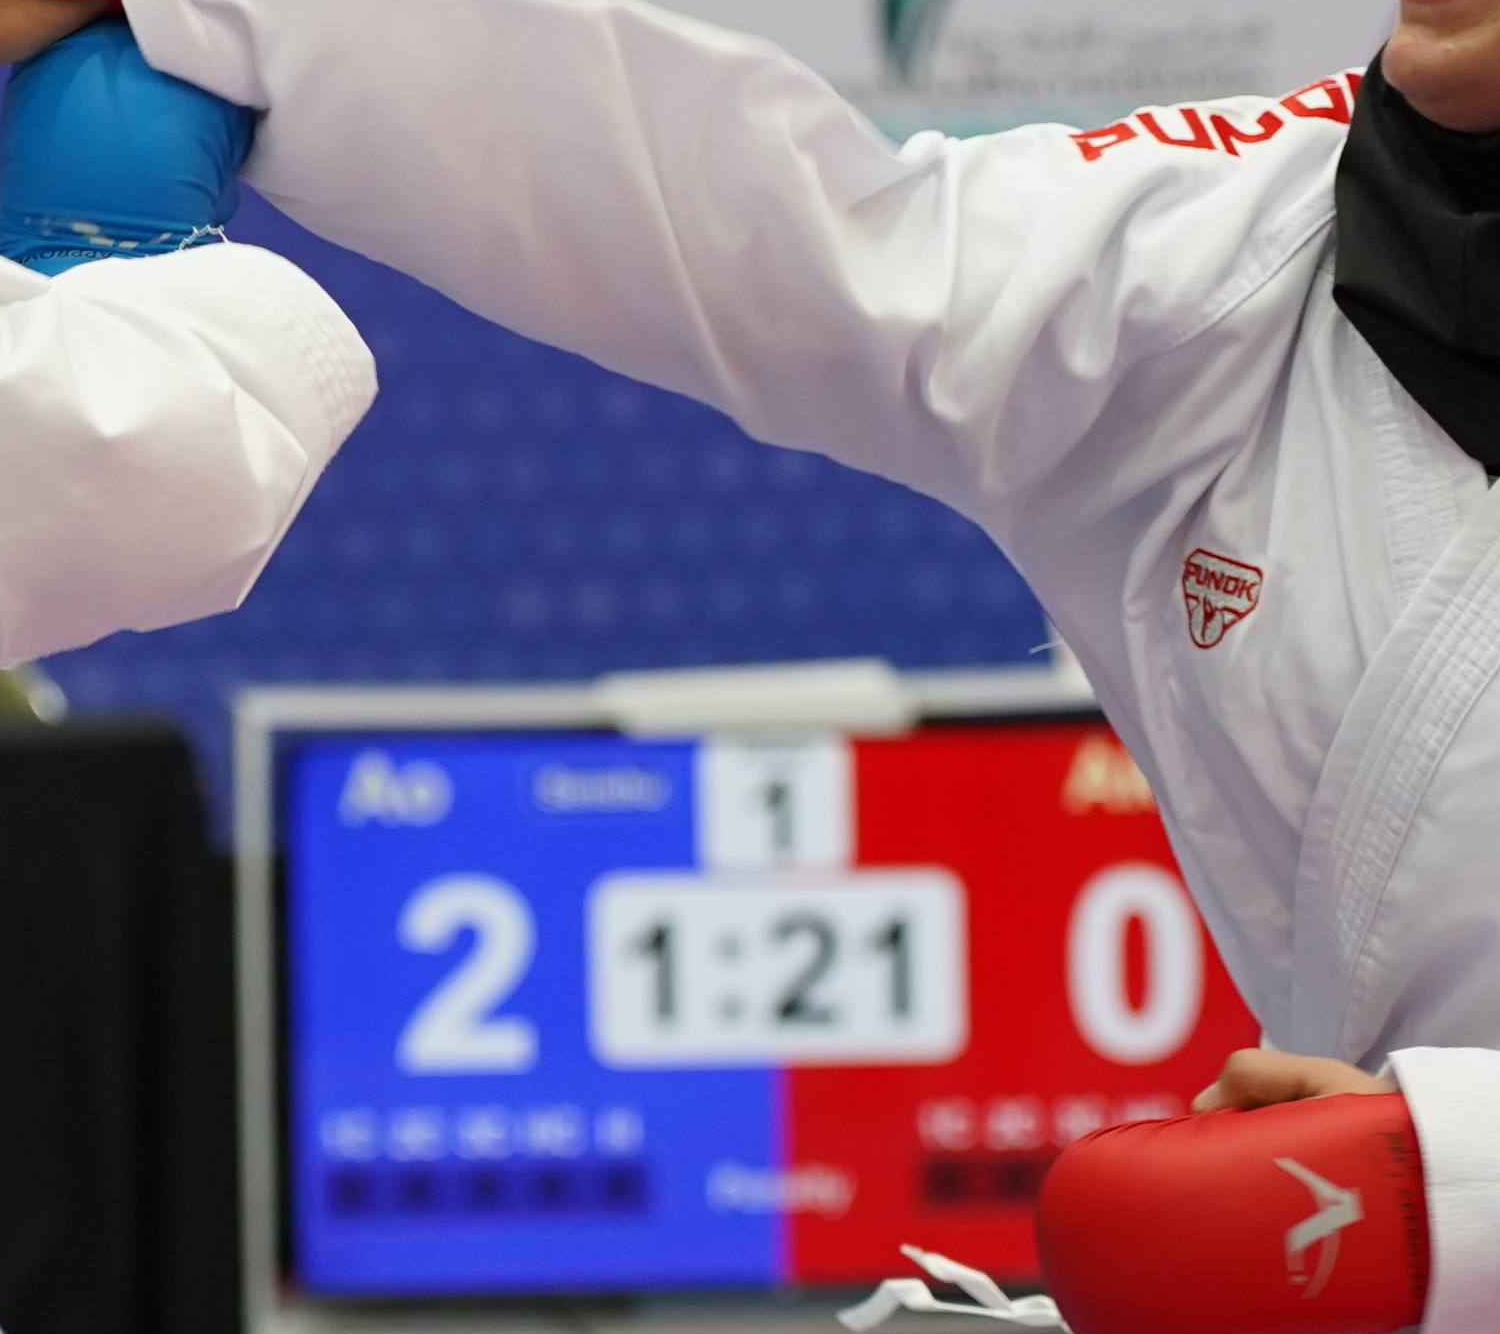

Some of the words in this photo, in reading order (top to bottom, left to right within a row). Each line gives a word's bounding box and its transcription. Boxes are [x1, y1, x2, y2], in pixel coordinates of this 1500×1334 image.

[1184, 561, 1261, 602] PUNOK
[343, 754, 452, 824] Ao
[758, 777, 794, 855] 1
[399, 875, 538, 1073] 2
[628, 911, 912, 1027] 1:21
[1066, 865, 1203, 1064] 0
